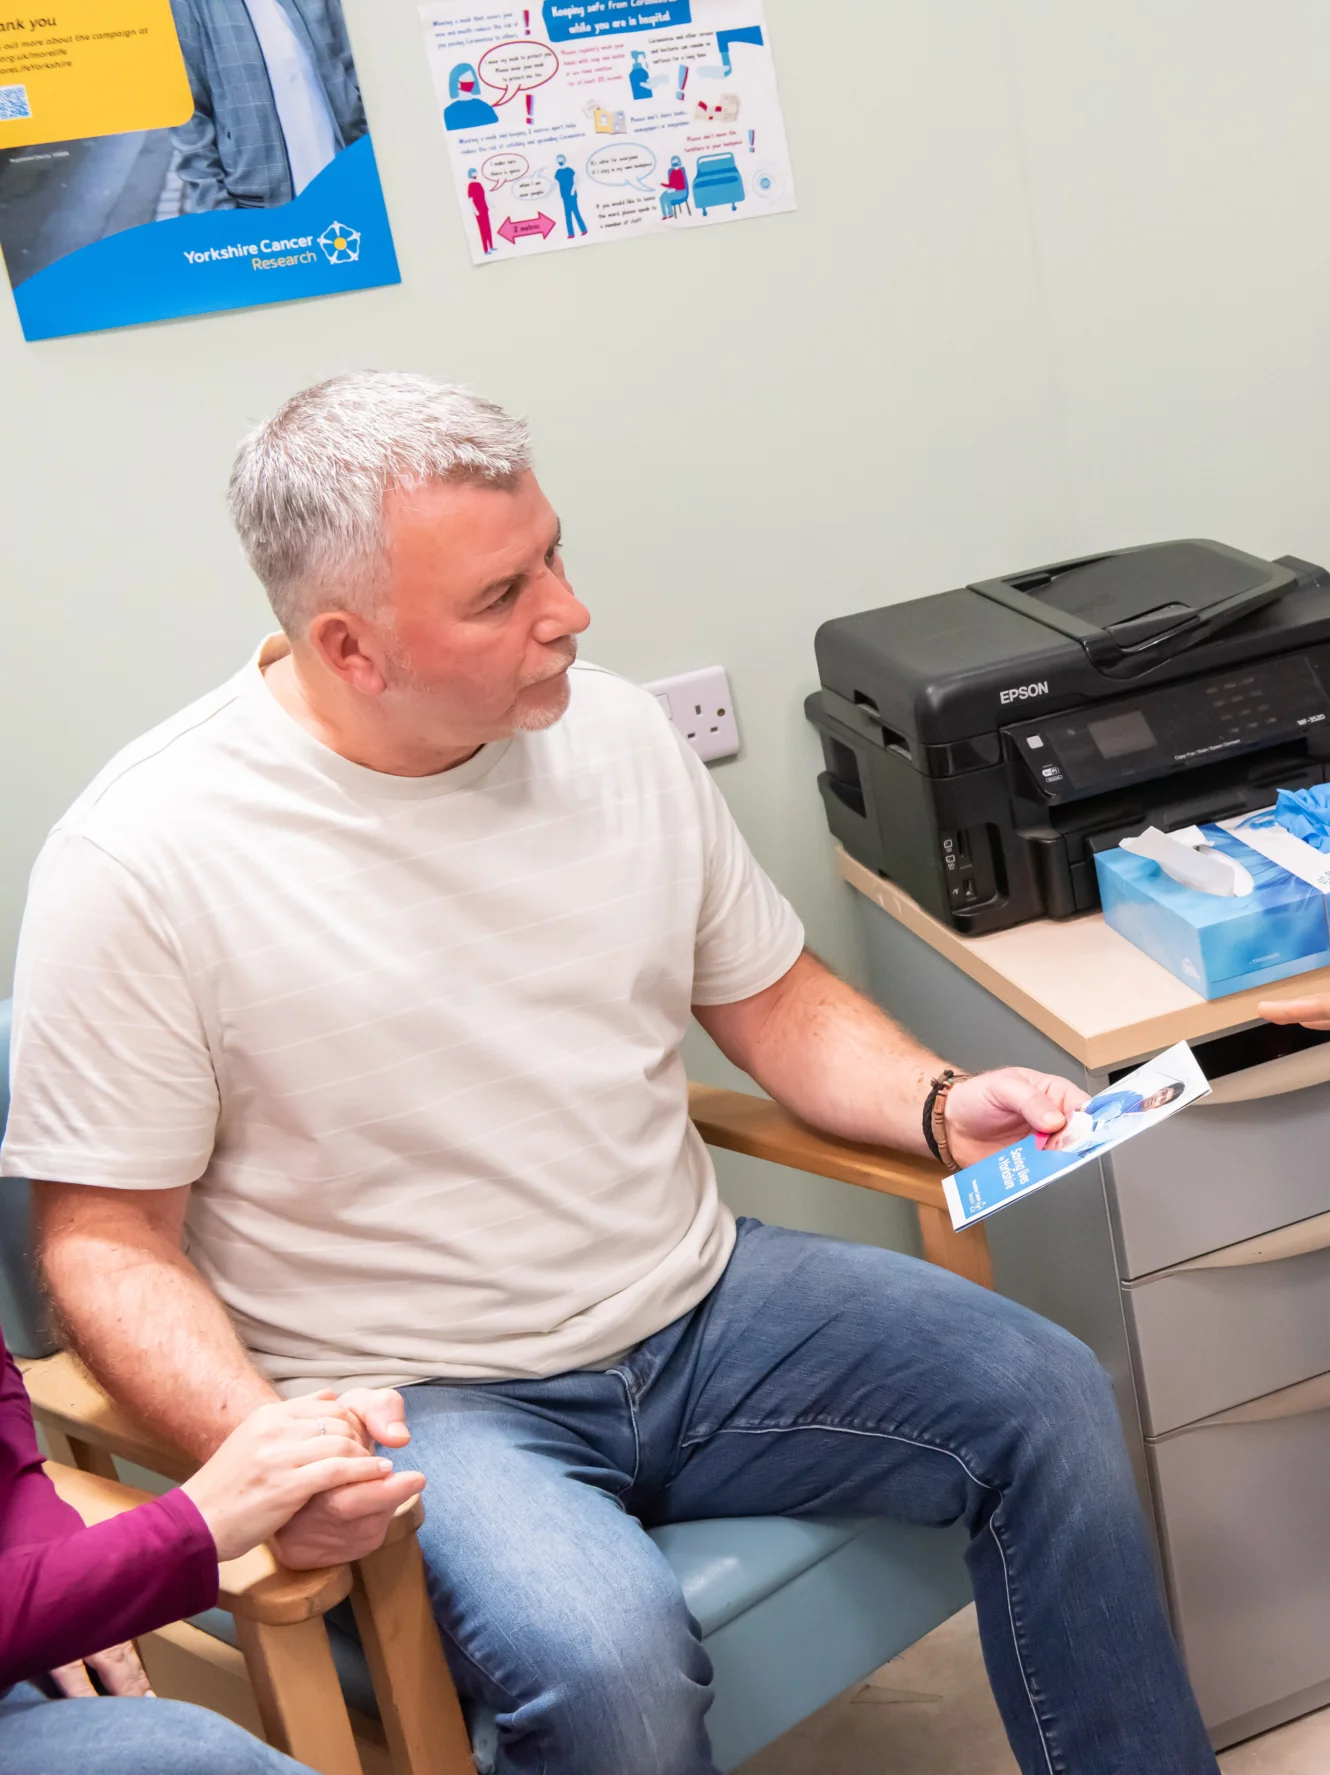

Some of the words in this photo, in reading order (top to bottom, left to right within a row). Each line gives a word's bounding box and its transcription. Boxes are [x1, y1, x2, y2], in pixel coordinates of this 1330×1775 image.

[551, 5, 585, 19] Keeping
[587, 2, 605, 13] safe
[608, 0, 628, 10] from
[29, 17, 56, 32] you
[568, 23, 592, 34] while
[594, 21, 610, 35] you
[611, 19, 626, 28] are
[628, 17, 637, 26] in
[638, 12, 671, 27] hospital
[21, 40, 43, 48] more
[46, 36, 73, 45] about
[75, 34, 90, 42] the
[92, 29, 136, 39] campaign
[183, 243, 258, 264] Yorkshire
[260, 236, 313, 253] Cancer
[252, 251, 317, 271] Research
[1000, 681, 1048, 704] EPSON
[1297, 714, 1325, 726] WF-3520
[1010, 1148, 1026, 1172] Saving
[999, 1158, 1016, 1190] Yorkshire
[1017, 1168, 1030, 1185] lives
